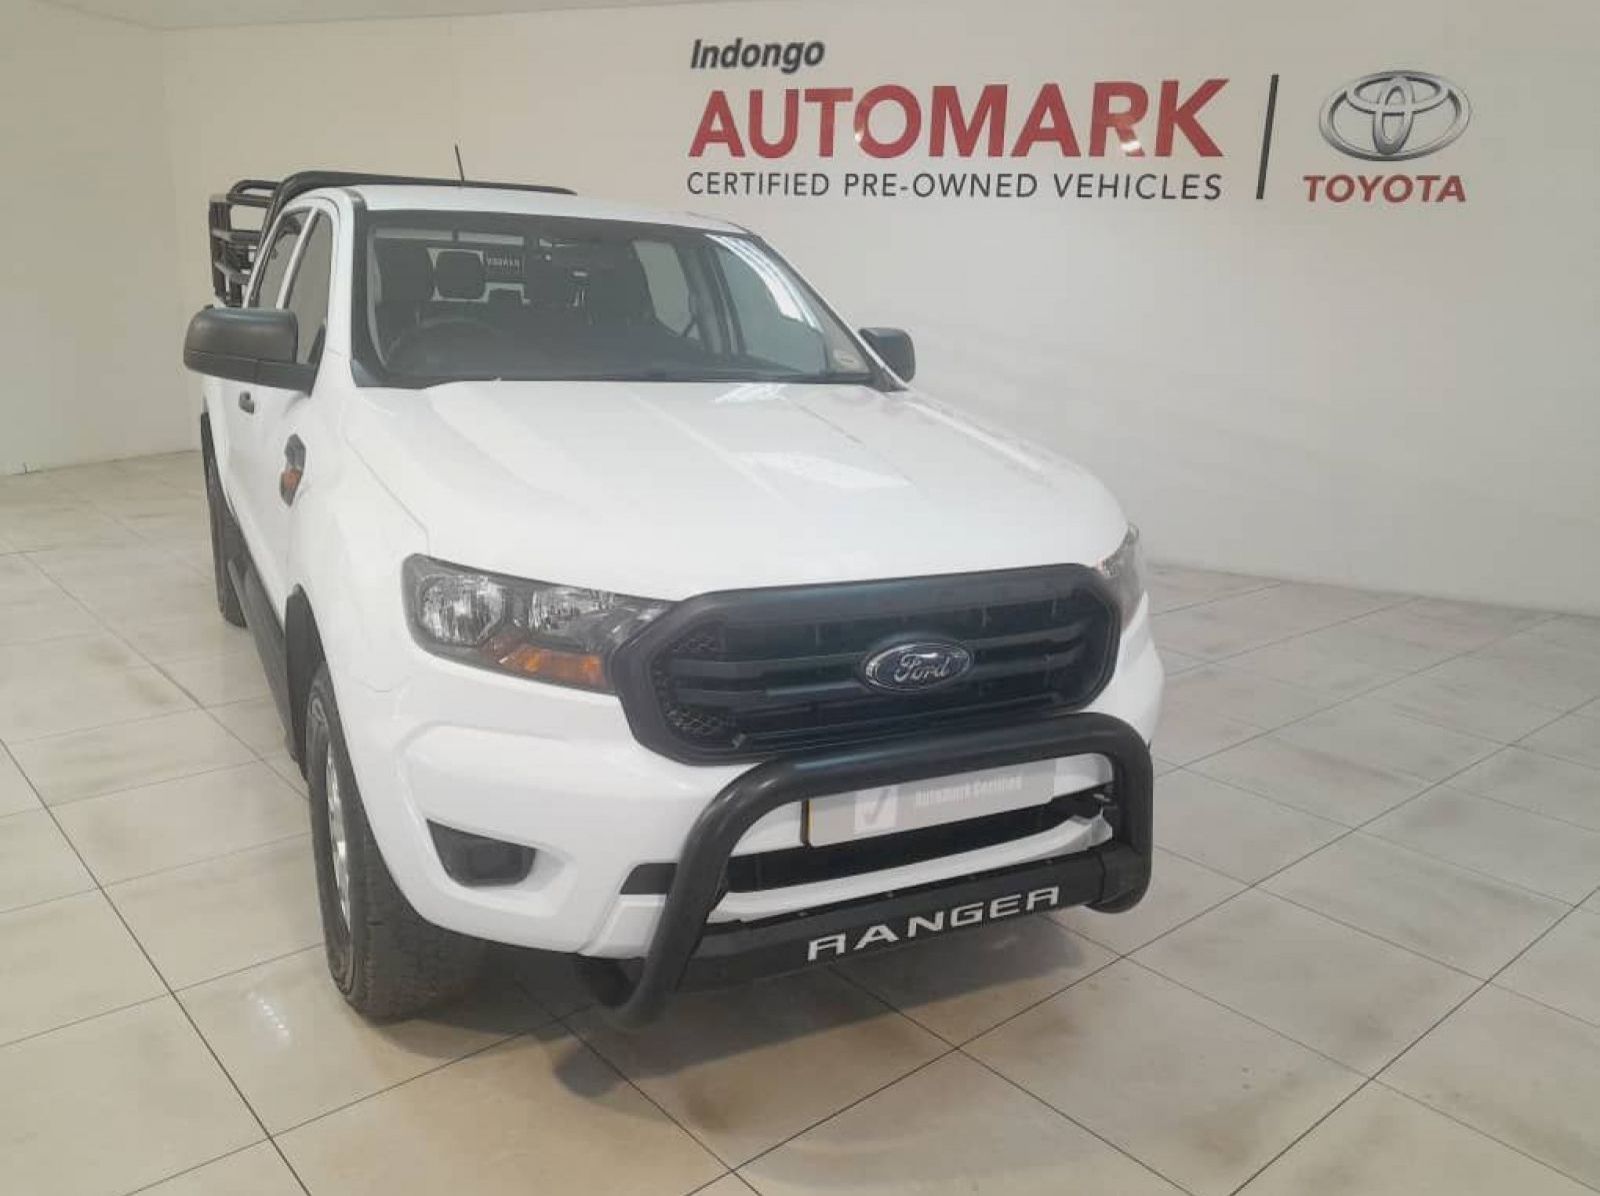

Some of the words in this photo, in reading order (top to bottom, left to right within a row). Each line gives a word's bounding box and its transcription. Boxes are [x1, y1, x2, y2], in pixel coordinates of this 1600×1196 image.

[690, 38, 825, 74] Indongo
[688, 79, 1229, 158] AUTOMARK
[687, 171, 829, 197] CERTIFIED
[844, 173, 1037, 199] PRE-OWNED
[1054, 174, 1222, 200] VEHICLES
[1303, 174, 1466, 203] TOYOTA
[894, 652, 951, 682] Ford
[807, 886, 1061, 961] RANGER
